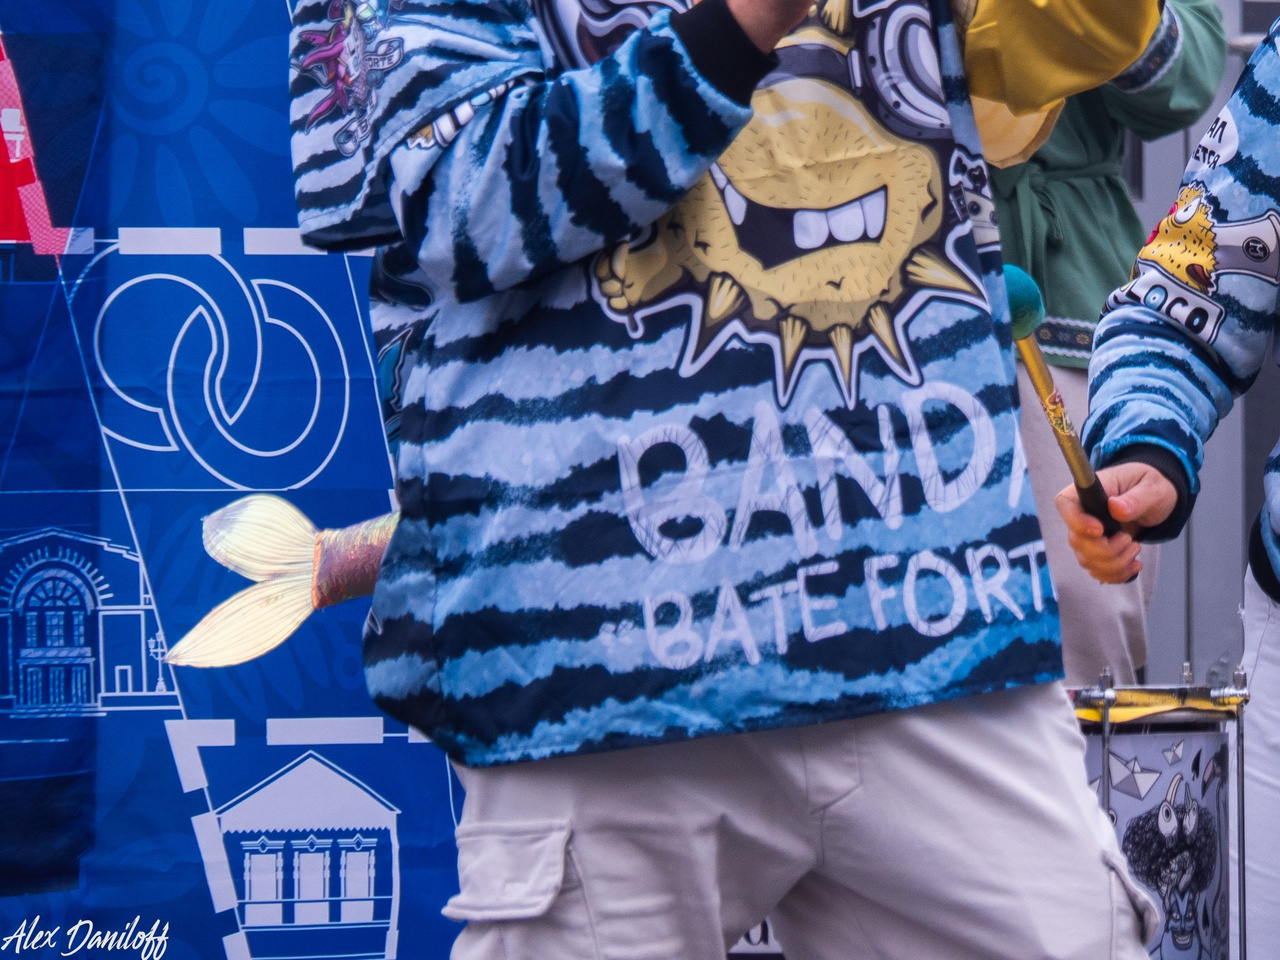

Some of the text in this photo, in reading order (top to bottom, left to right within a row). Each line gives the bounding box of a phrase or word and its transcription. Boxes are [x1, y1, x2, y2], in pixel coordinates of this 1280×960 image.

[1192, 143, 1221, 170] ЕТСЯ
[644, 539, 1058, 670] BATE FORT
